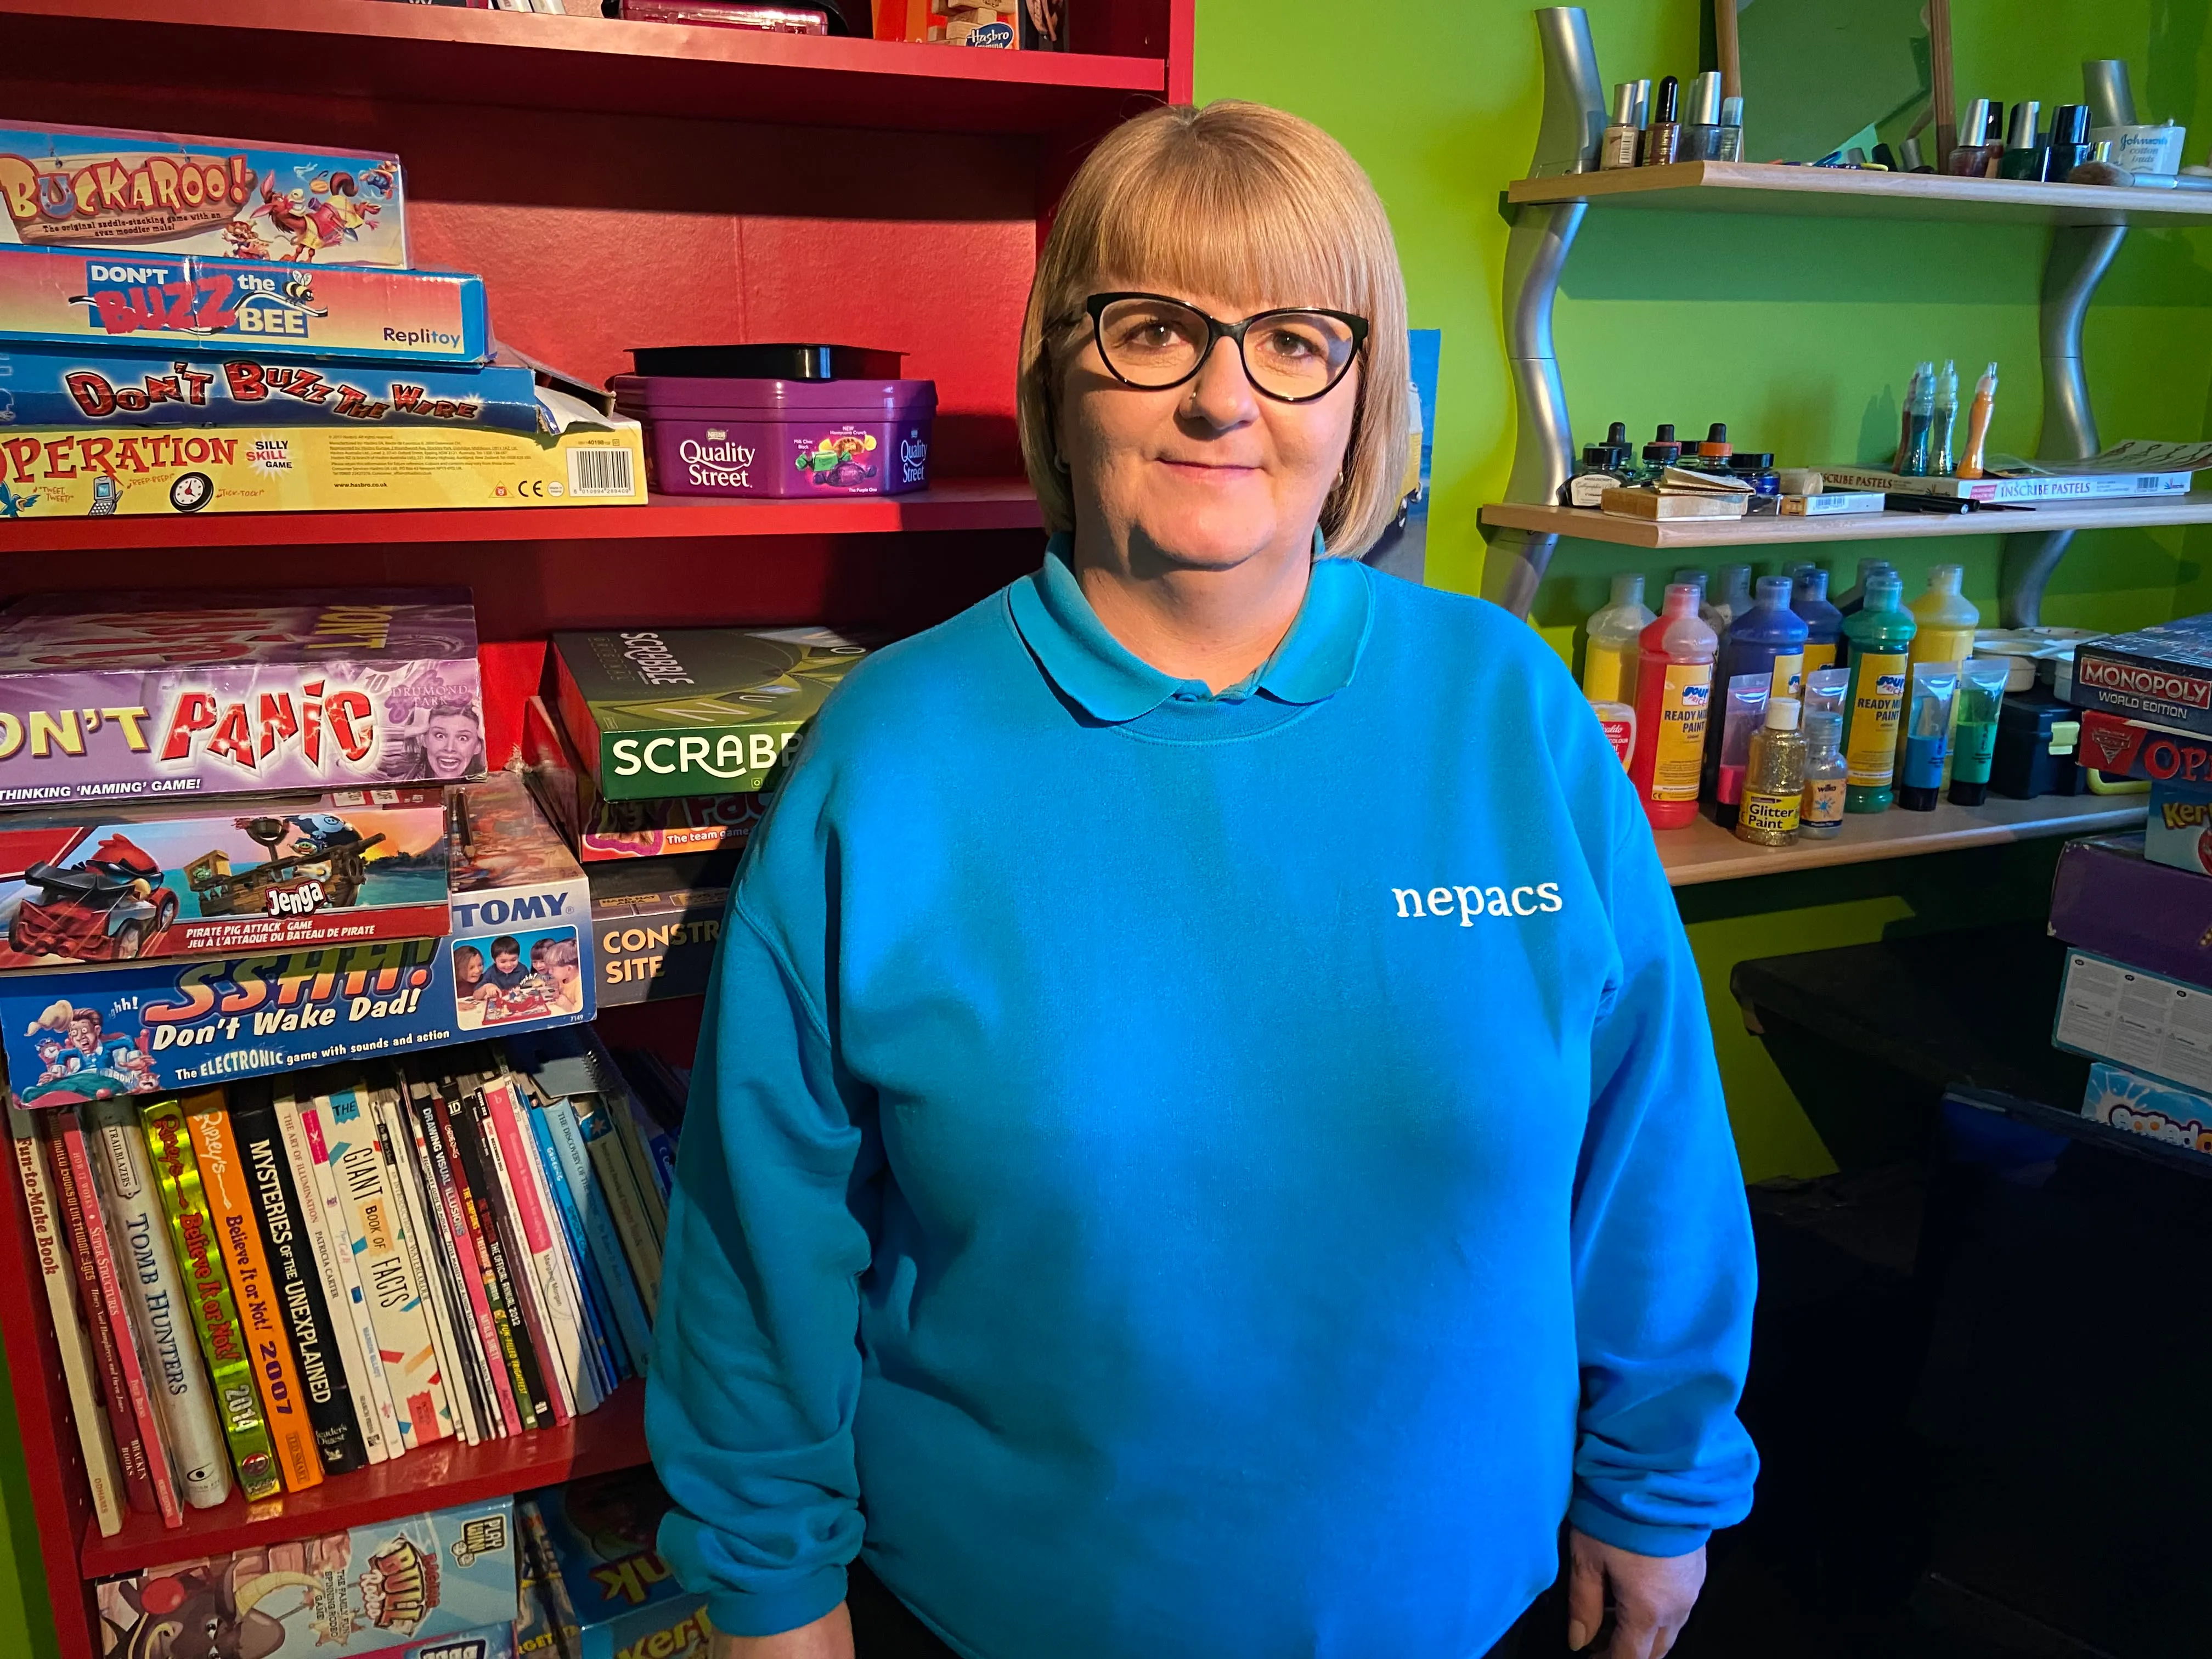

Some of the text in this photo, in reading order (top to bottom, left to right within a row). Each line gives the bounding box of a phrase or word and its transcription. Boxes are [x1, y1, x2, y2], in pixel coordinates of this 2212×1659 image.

[967, 29, 1009, 44] Hasbro
[0, 154, 247, 218] BUCKAROO!
[61, 222, 95, 232] original
[98, 216, 165, 228] saddle-stacking
[167, 215, 188, 224] game
[190, 212, 209, 221] with
[116, 226, 150, 235] moodier
[91, 264, 168, 284] DON'T
[237, 274, 275, 292] the
[93, 275, 237, 334] BUZZ
[238, 308, 304, 334] BEE
[383, 328, 460, 348] Replitoy
[65, 359, 479, 419] DON'T BUZZ THE WIRE
[0, 435, 238, 484] PERATION
[246, 450, 286, 461] SKILL
[255, 441, 288, 450] SILLY
[679, 440, 755, 472] Quality
[900, 439, 928, 467] Quality
[690, 462, 753, 488] Street
[903, 461, 924, 484] Street
[1856, 476, 1893, 489] PASTELS
[2001, 484, 2049, 498] INSCRIBE
[2051, 482, 2090, 495] PASTELS
[620, 633, 695, 685] SCRABBLE
[392, 685, 467, 697] DRUMOND
[2084, 662, 2209, 706] MONOPOLY
[1664, 710, 1696, 720] READY
[1858, 698, 1889, 709] READY
[1876, 710, 1900, 721] PAINT
[2098, 691, 2188, 720] WORLD EDITION
[160, 679, 374, 770] PANIC
[1683, 723, 1705, 733] PAINT
[0, 786, 71, 800] THINKING
[151, 778, 201, 791] GAME!
[1748, 815, 1783, 829] Paint
[1750, 804, 1794, 817] Glitter
[667, 828, 749, 844] The team game
[269, 881, 324, 916] Jenga
[452, 892, 568, 928] TOMY
[1391, 883, 1562, 927] nepacs
[186, 921, 313, 938] PIRATE PIG ATTACK GAME
[188, 925, 375, 949] JEU À L'ATTAQUE DU BATEAU DE PIRATE
[606, 955, 665, 984] SITE
[153, 988, 421, 1051] Don't Wake Dad!
[176, 1029, 450, 1081] The ELECTRONIC game with sounds and action
[448, 1102, 461, 1115] 1D
[109, 1127, 131, 1187] TRAILBLAZERS
[557, 1111, 566, 1127] THE
[563, 1127, 580, 1165] DISCOVERY
[578, 1166, 585, 1175] OF
[423, 1108, 466, 1237] DRAWING VISUAL ILLUSIONS
[16, 1137, 59, 1275] Fun-to-Make Book
[284, 1114, 338, 1299] THE ART OF ILLUMINATION PATRICIA CARTER
[332, 1101, 409, 1308] THE GIANT BOOK OF FACTS
[466, 1200, 480, 1229] SIMPSONS
[73, 1153, 119, 1316] HOW WORKS SUPER STRUCTURES
[490, 1242, 500, 1255] THE
[250, 1138, 331, 1404] MYSTERIES OF THE UNEXPLAINED
[494, 1255, 507, 1283] OFFICIAL
[544, 1254, 562, 1307] Margaret Morgan
[179, 1212, 242, 1360] Believe It or Not!
[126, 1212, 187, 1396] TOMB HUNTERS
[225, 1215, 293, 1415] Believe It or Not! 2007
[509, 1307, 521, 1327] 2012
[501, 1324, 517, 1359] FUN-FILLED
[224, 1384, 259, 1432] 2014
[122, 1447, 134, 1476] BOOKS
[131, 1439, 147, 1480] BRACKEN
[314, 1595, 325, 1620] GAME
[337, 1570, 351, 1634] THE FAMILY FUN
